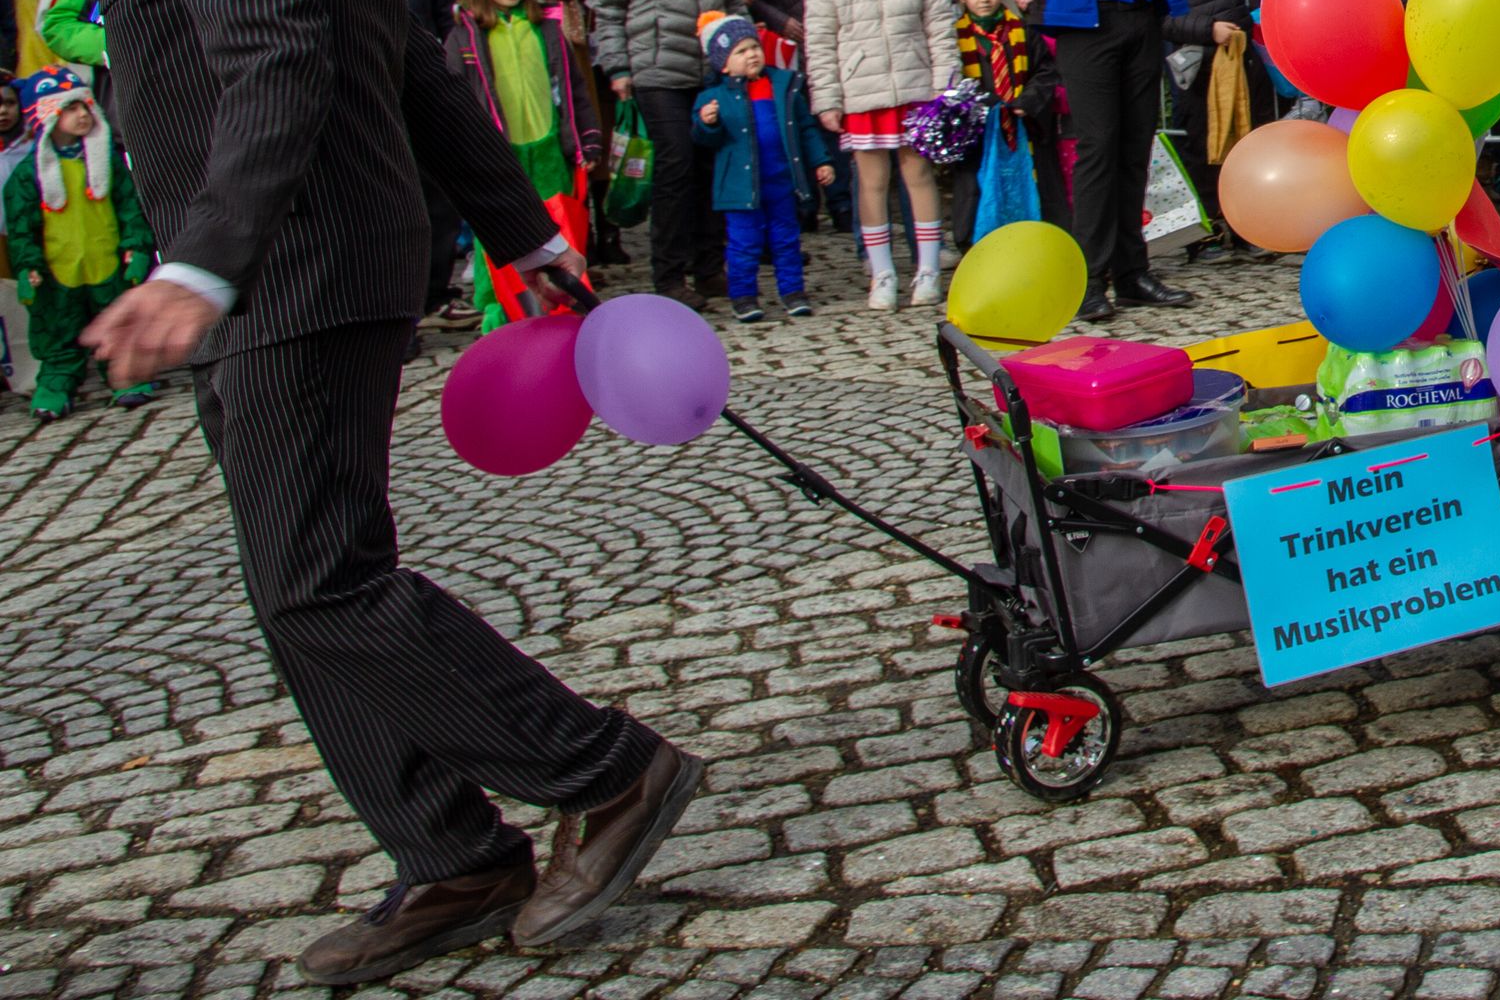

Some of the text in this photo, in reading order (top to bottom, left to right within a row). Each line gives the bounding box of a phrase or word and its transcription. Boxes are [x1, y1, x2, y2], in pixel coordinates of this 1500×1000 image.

[1386, 387, 1463, 408] ROCHEVAL
[1326, 470, 1404, 504] Mein
[1279, 498, 1462, 558] Trinkverein
[1326, 548, 1437, 592] hat ein
